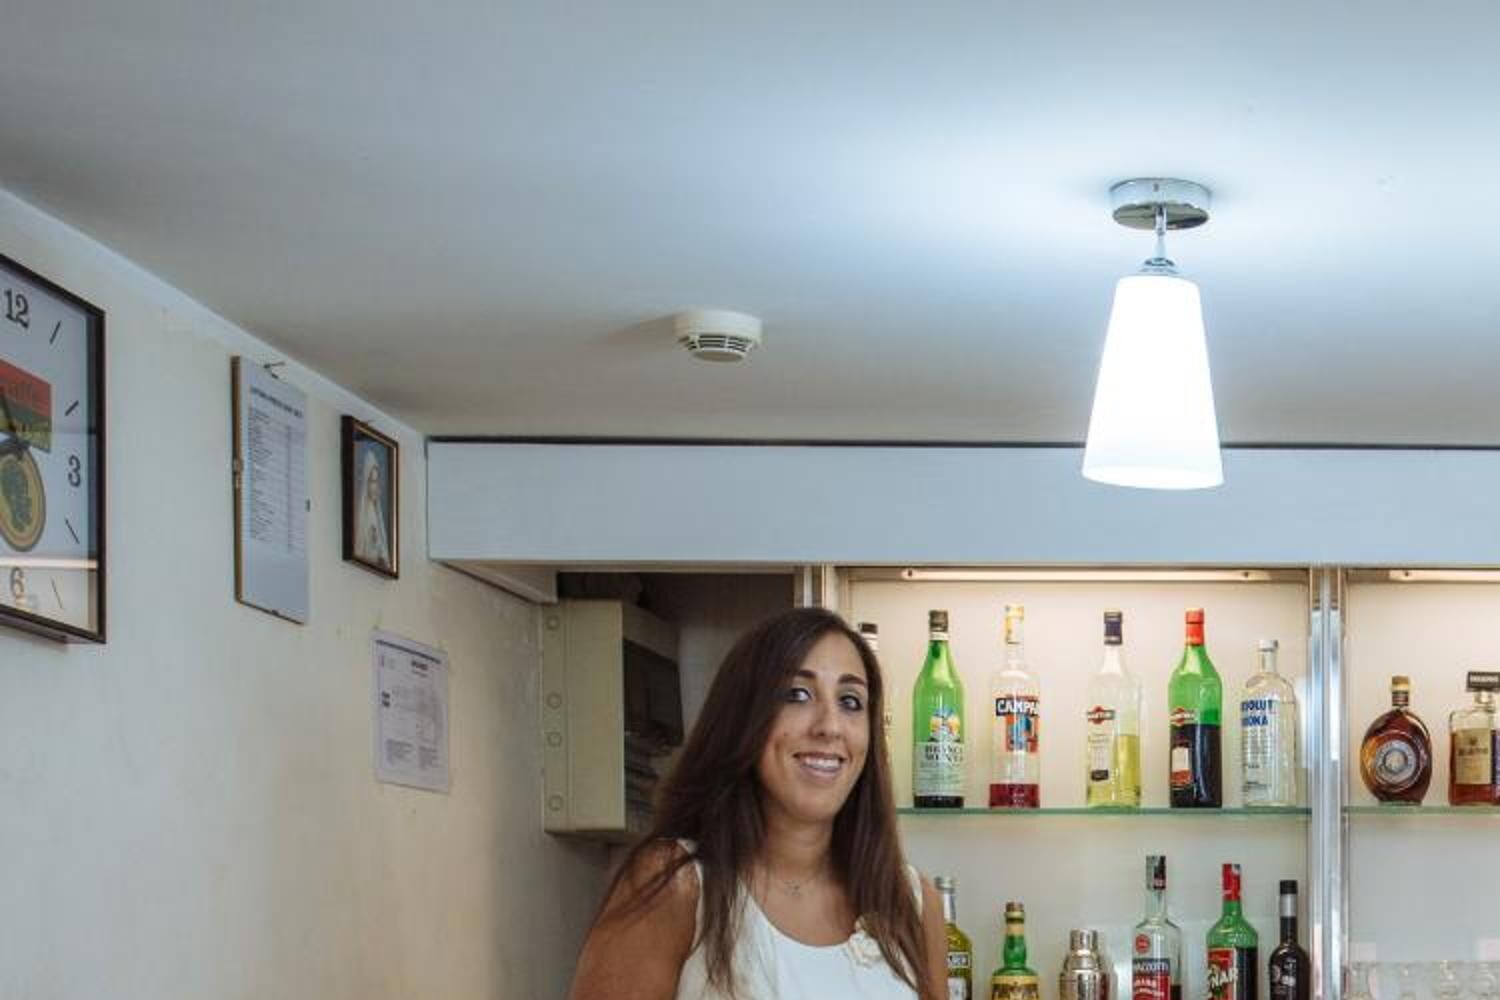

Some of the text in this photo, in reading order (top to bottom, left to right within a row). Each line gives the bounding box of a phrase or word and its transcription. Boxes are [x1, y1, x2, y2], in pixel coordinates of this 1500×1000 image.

[5, 288, 30, 330] 12
[67, 455, 81, 488] 3
[10, 566, 24, 600] 6
